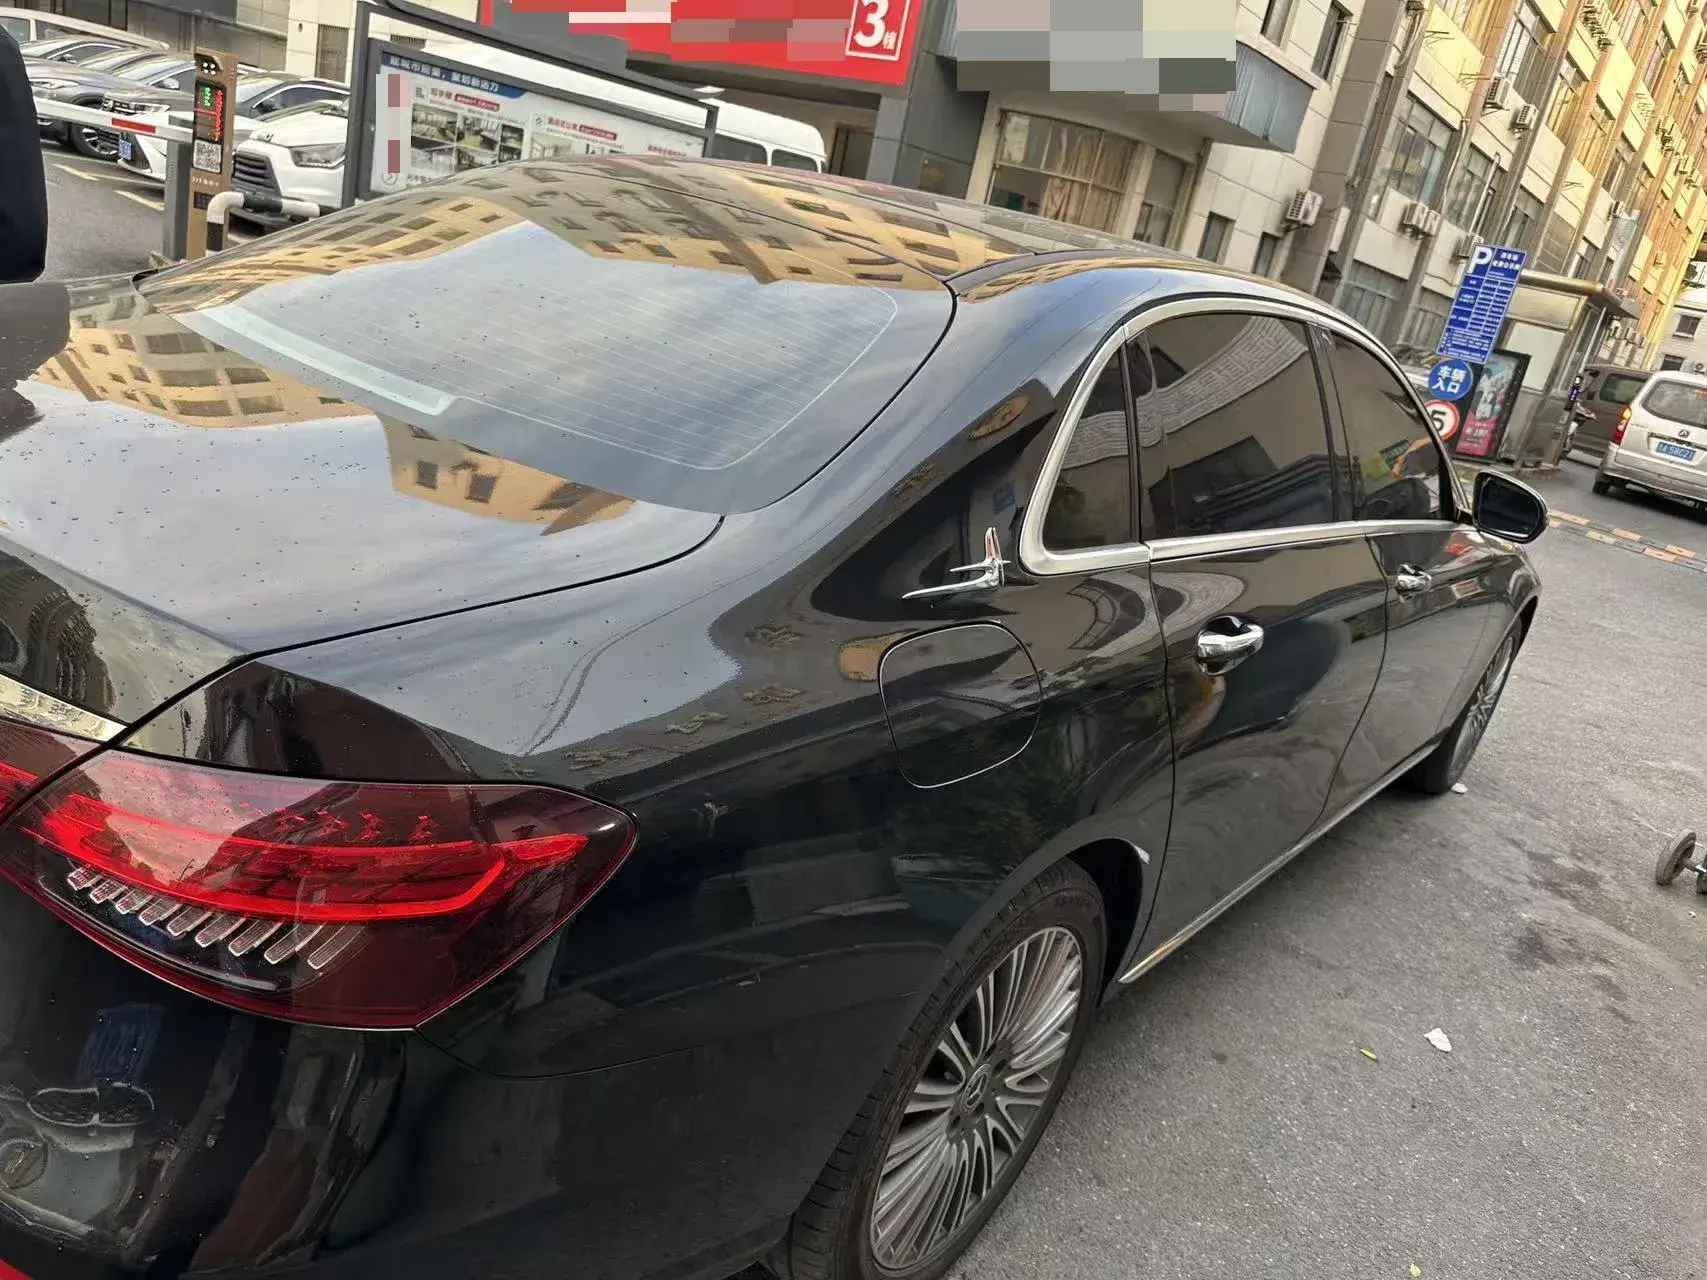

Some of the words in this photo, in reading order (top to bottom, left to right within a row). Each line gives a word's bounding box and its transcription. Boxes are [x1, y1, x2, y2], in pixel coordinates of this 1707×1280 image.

[1466, 246, 1493, 274] P
[1437, 366, 1467, 383] 车辆
[1431, 376, 1461, 394] 入口
[1431, 409, 1447, 432] 5
